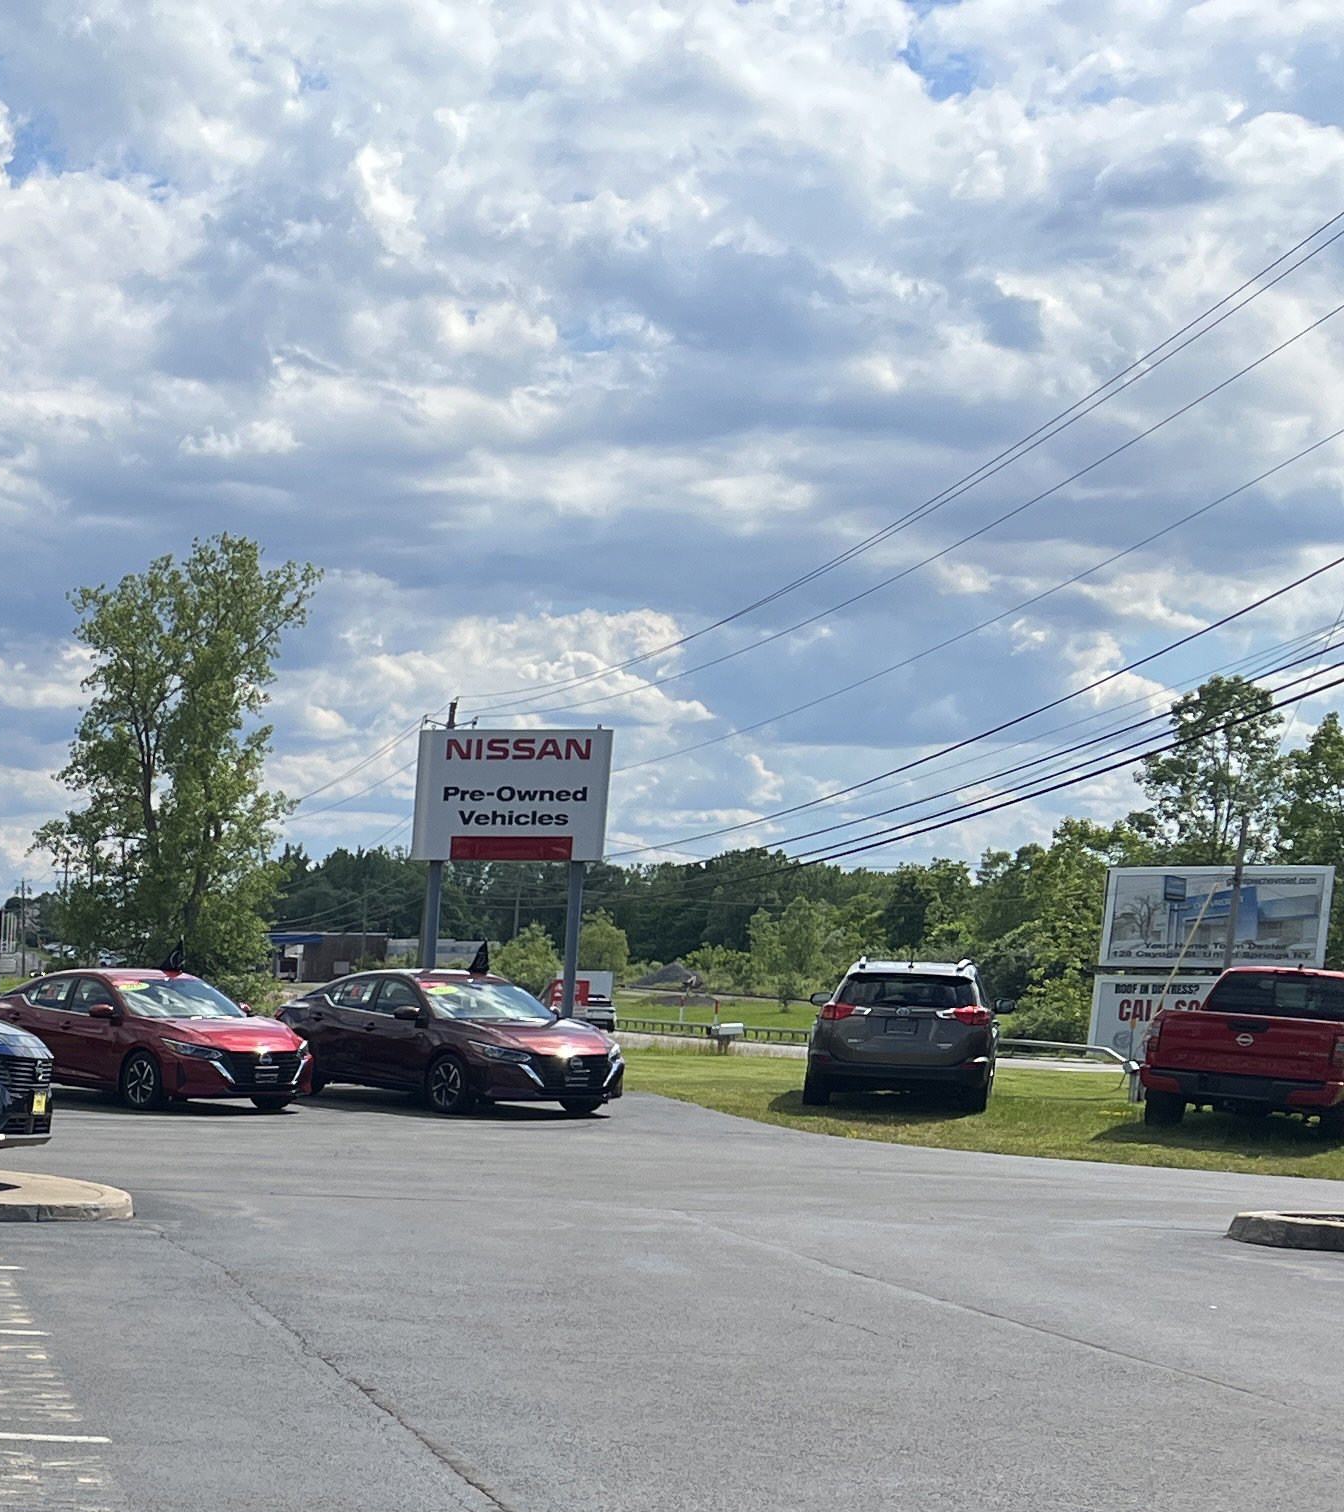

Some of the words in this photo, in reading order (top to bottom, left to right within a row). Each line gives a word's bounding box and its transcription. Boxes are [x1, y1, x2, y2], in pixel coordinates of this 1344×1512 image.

[445, 738, 592, 761] NISSAN
[442, 785, 588, 802] Pre-Owned
[458, 810, 569, 826] Vehicles
[1144, 942, 1171, 950] Your
[1213, 942, 1245, 950] Ton
